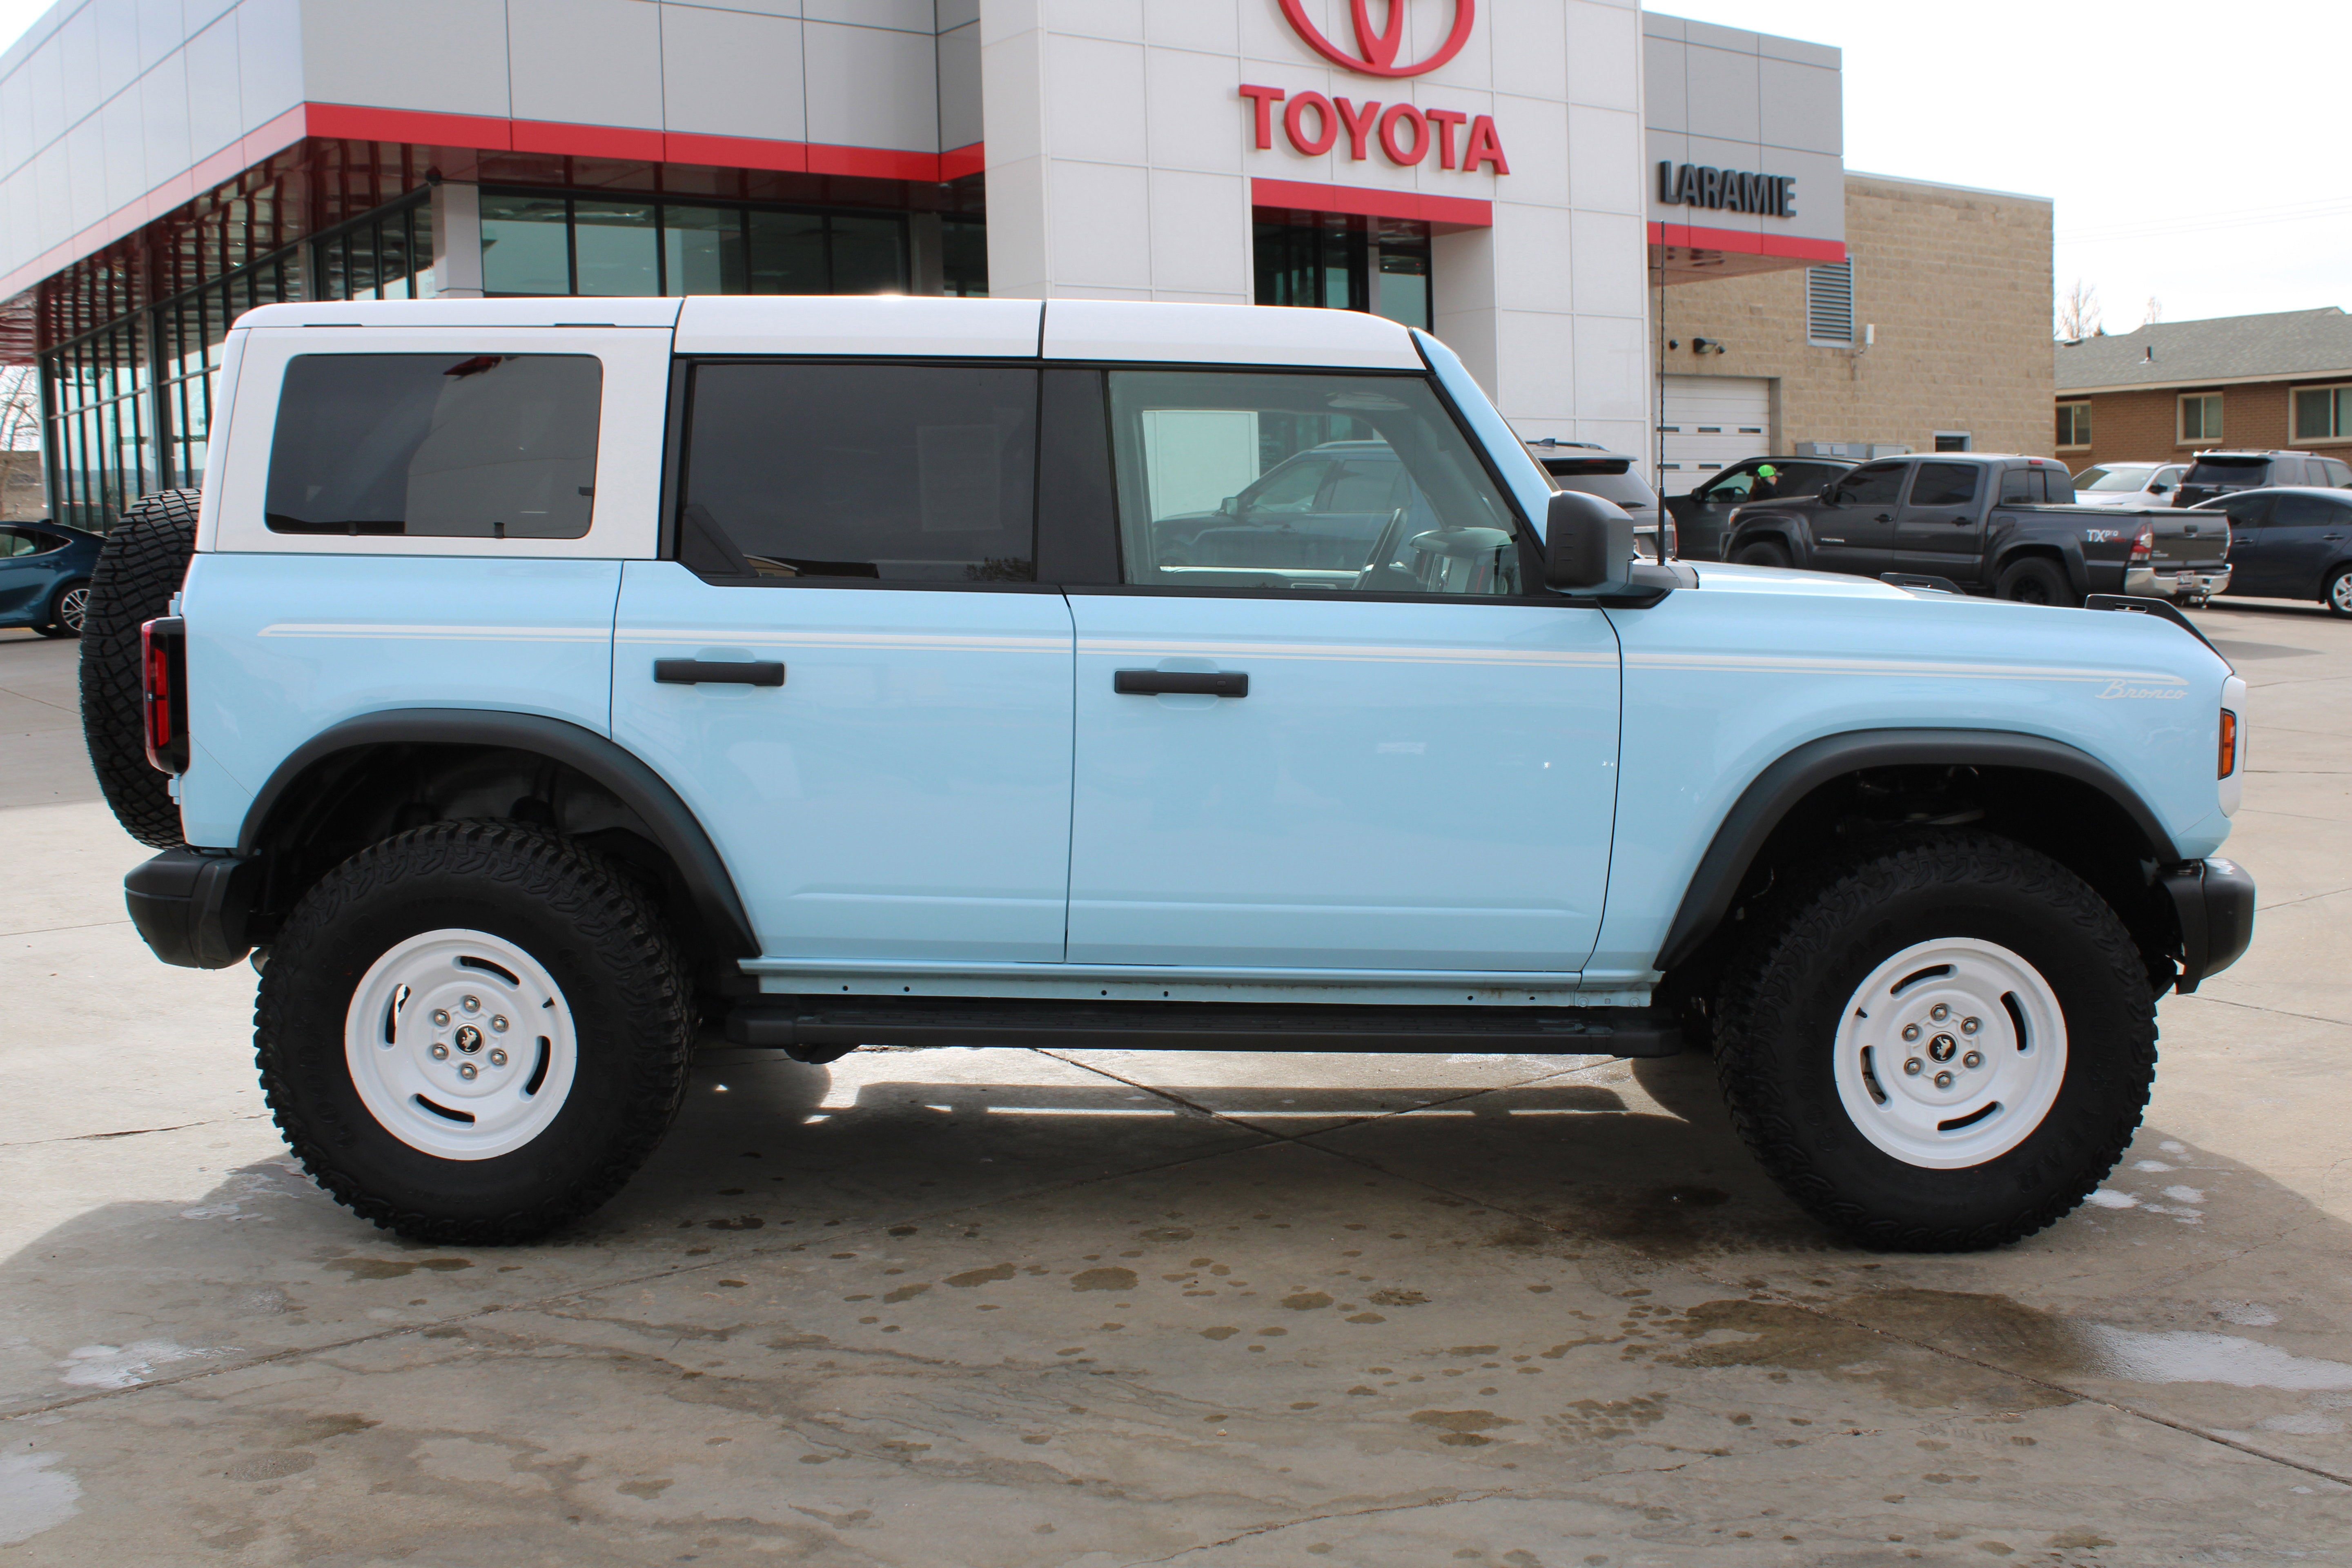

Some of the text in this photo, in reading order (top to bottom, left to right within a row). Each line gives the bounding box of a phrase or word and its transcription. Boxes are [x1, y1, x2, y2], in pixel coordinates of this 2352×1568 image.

[1239, 84, 1510, 175] TOYOTA
[1659, 160, 1796, 217] LARAMIE
[2095, 678, 2188, 699] Bronco
